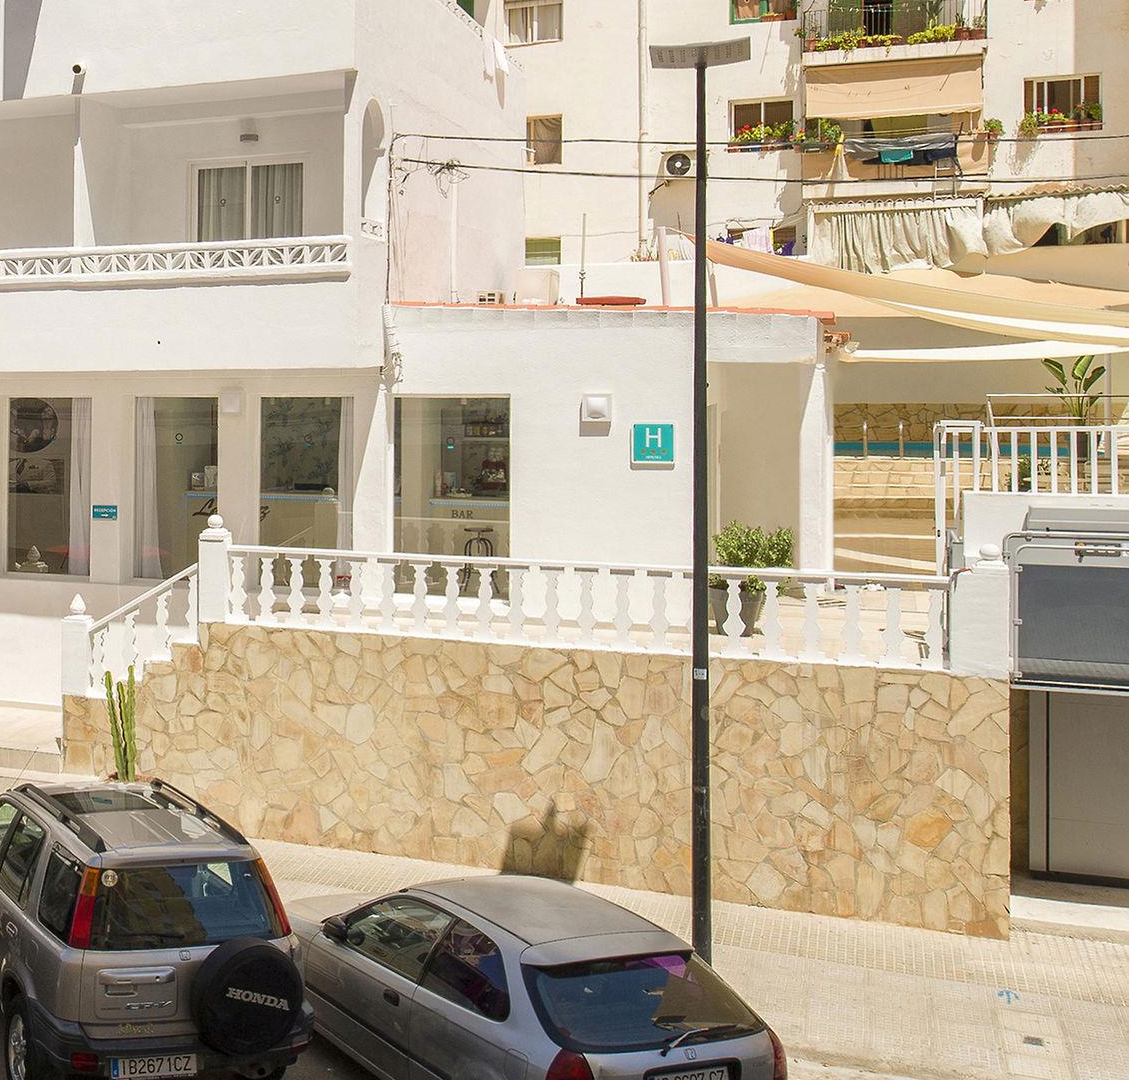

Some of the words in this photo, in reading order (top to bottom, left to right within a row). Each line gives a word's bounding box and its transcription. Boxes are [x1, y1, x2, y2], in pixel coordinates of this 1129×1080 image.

[645, 427, 662, 448] H
[451, 509, 474, 519] BAR
[226, 987, 290, 1011] HONDA
